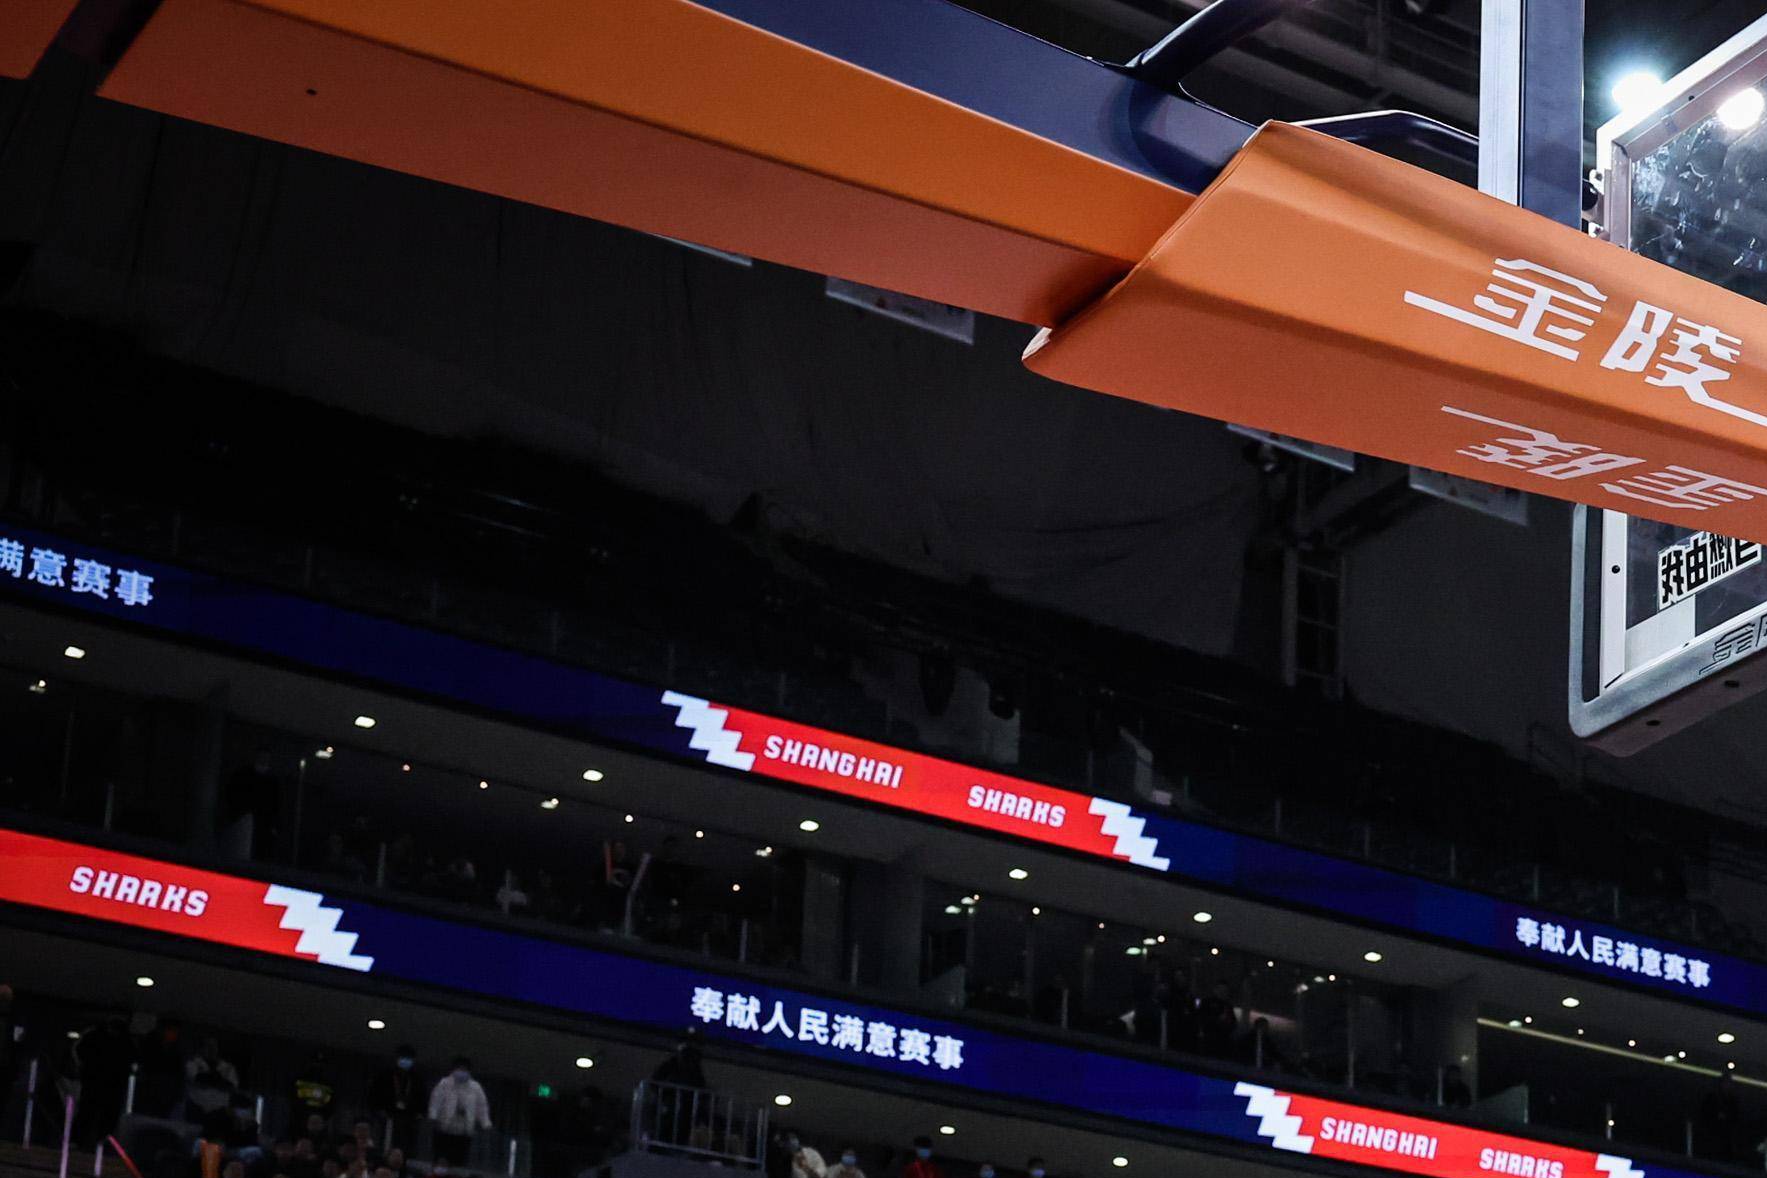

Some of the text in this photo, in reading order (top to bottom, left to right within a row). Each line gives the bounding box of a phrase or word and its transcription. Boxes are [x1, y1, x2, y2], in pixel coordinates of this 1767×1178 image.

[0, 538, 154, 606] 满意赛事
[764, 735, 1066, 827] SHANGHAI SHARKS
[69, 865, 210, 918] SHARKS
[1515, 917, 1711, 988] 奉献人民满意赛事
[691, 987, 964, 1070] 奉献人民满意赛事
[1320, 1117, 1438, 1160] SHANGHAI
